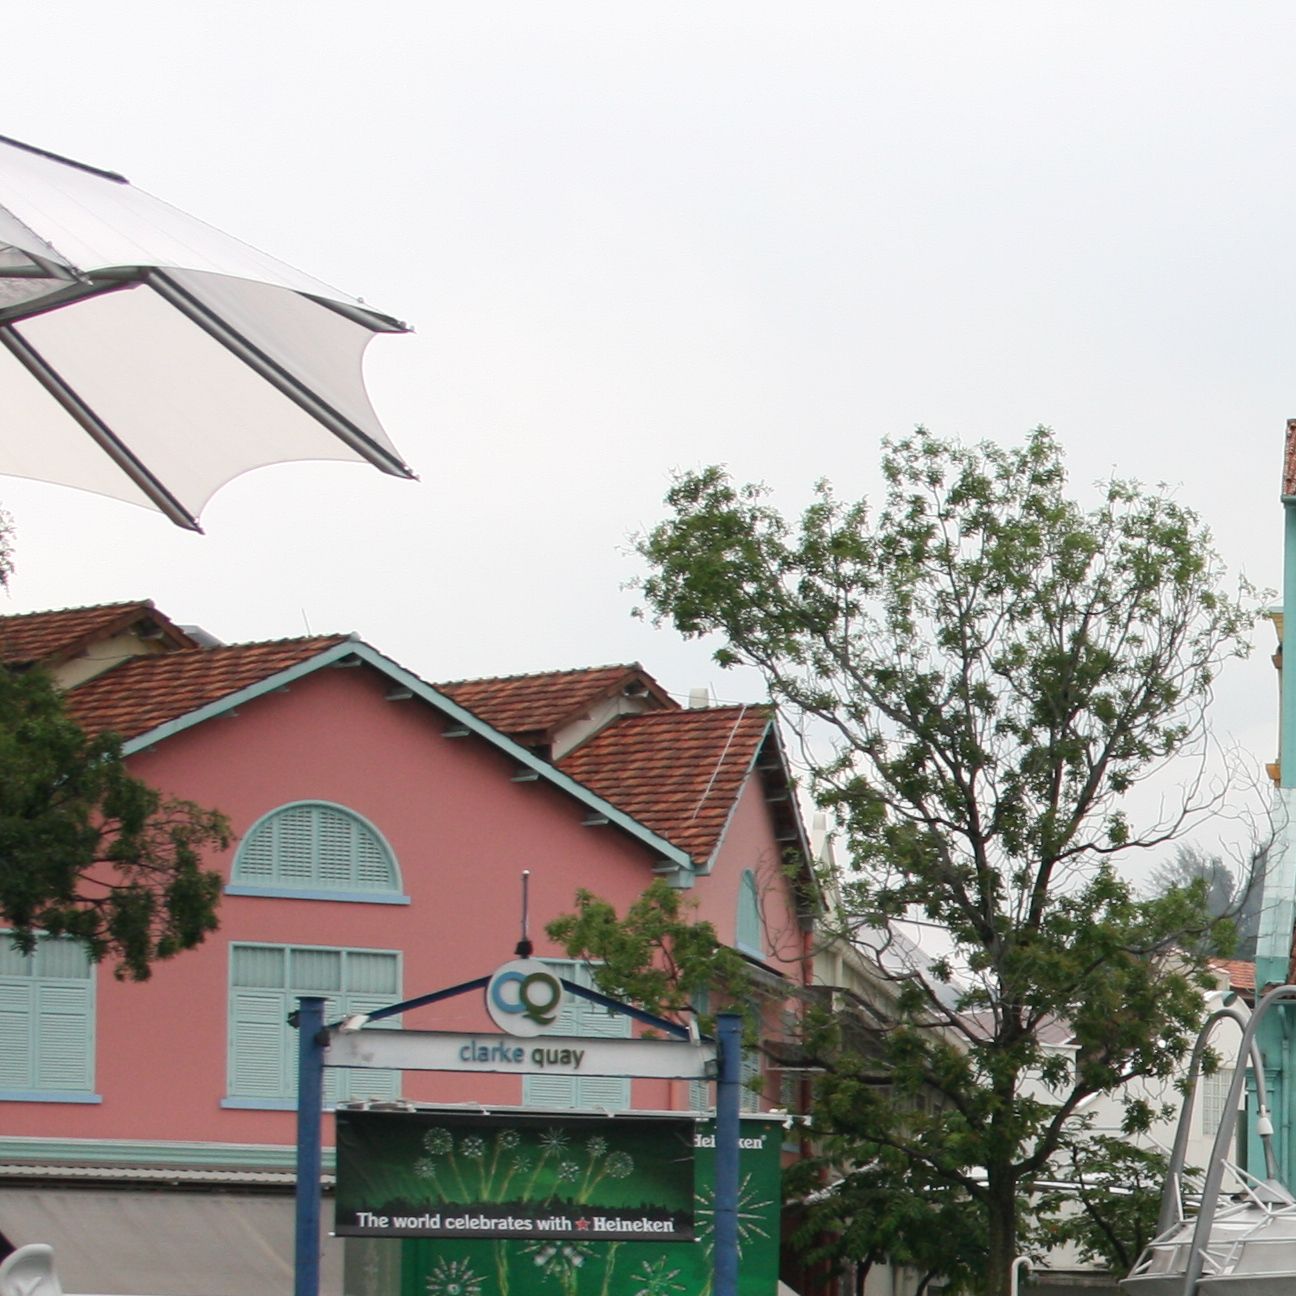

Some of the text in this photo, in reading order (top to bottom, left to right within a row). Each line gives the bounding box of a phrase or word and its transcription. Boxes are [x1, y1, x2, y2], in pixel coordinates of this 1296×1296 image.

[459, 1040, 585, 1070] clarke quay
[356, 1212, 674, 1233] The world celebrates with Heineken
